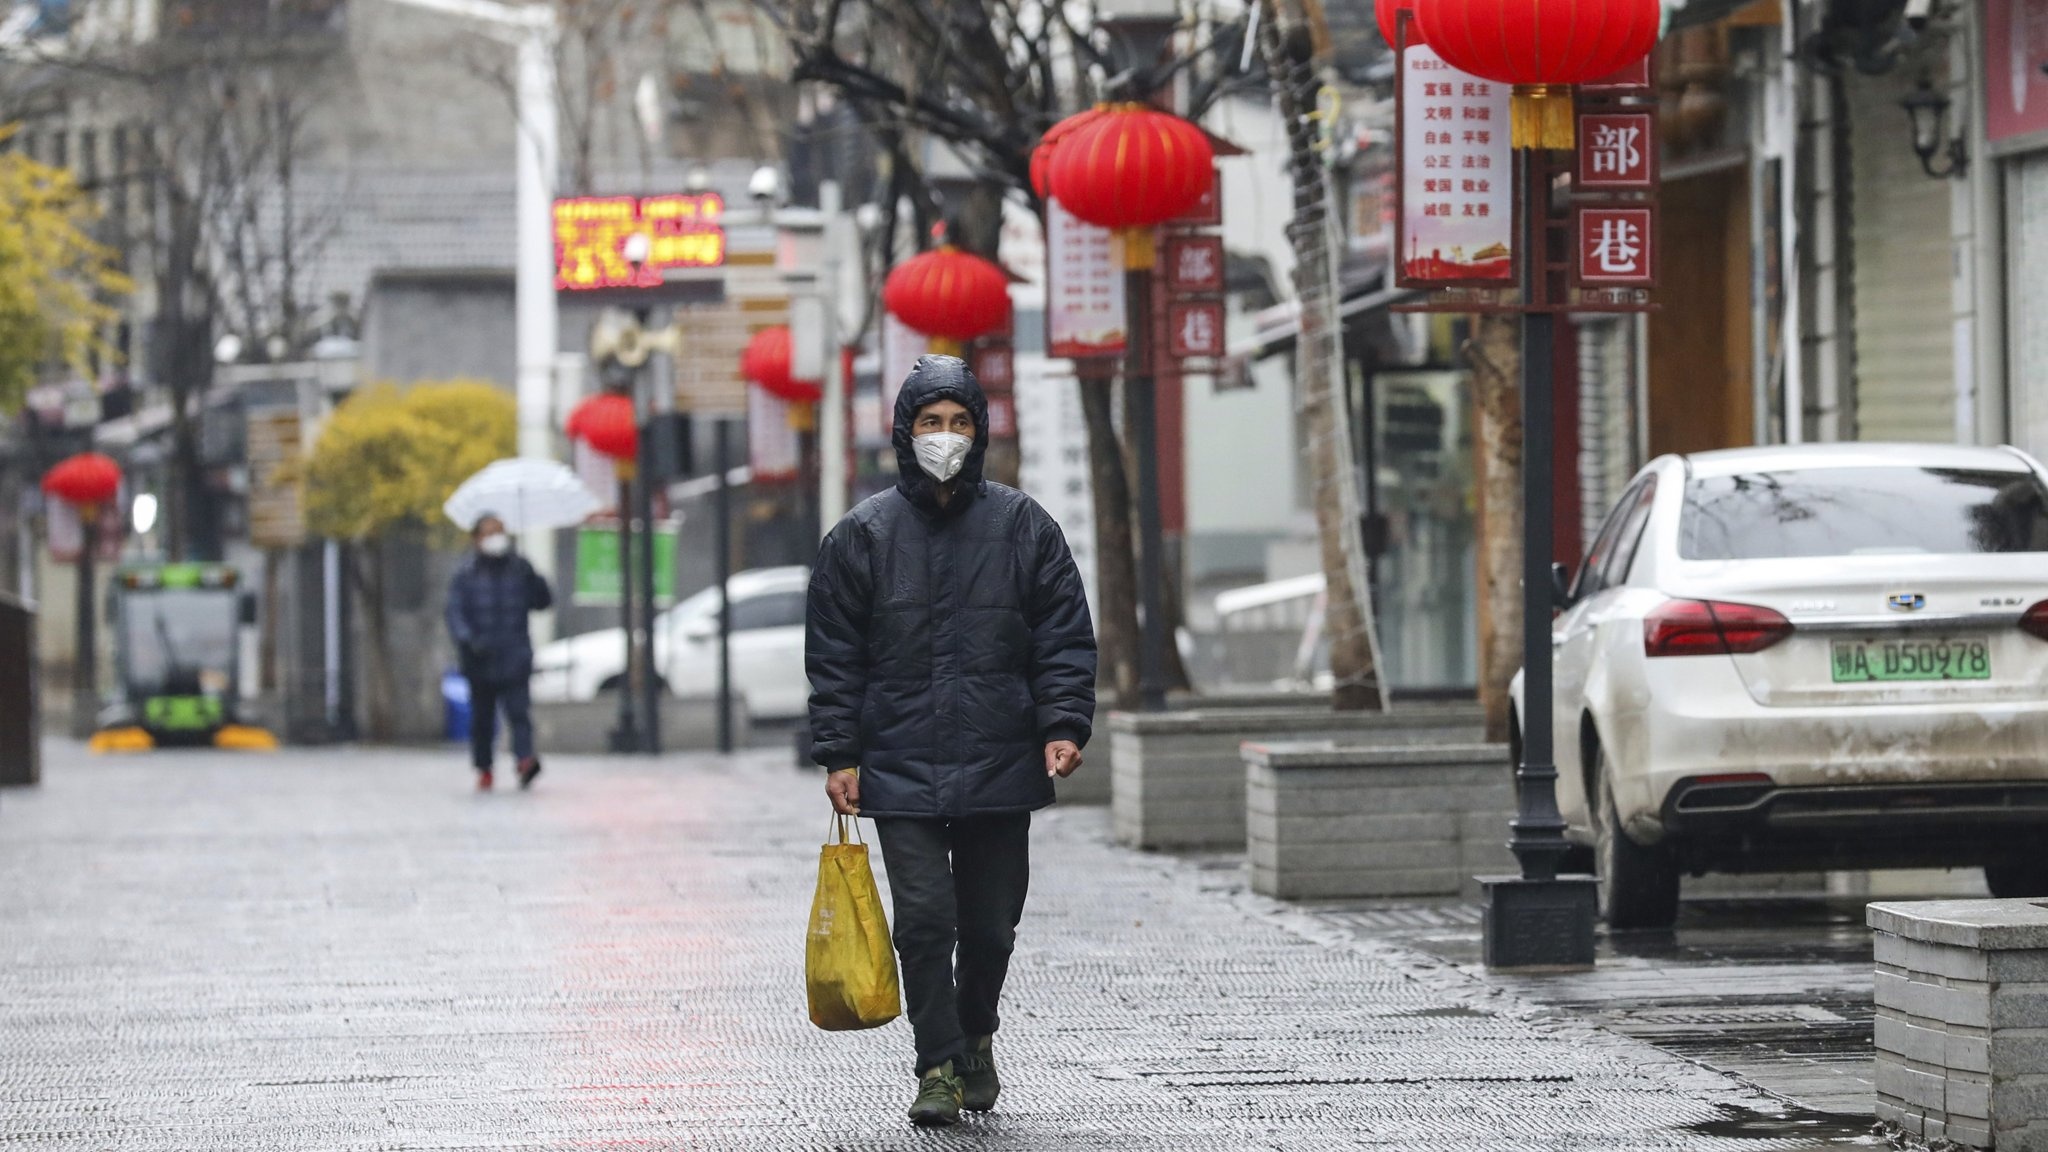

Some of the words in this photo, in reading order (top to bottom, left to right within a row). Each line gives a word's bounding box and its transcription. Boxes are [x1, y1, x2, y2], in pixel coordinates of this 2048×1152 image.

[1424, 82, 1452, 96] 富强
[1462, 82, 1490, 96] 民主
[1424, 106, 1452, 121] 文明
[1462, 106, 1490, 121] 和谐
[1424, 131, 1452, 145] 自由
[1462, 131, 1490, 145] 平等
[1424, 154, 1452, 168] 公正
[1462, 154, 1490, 168] 法治
[1424, 178, 1452, 192] 爱国
[1462, 178, 1490, 192] 敬业
[1424, 202, 1452, 217] 诚信
[1884, 641, 1986, 674] D50978
